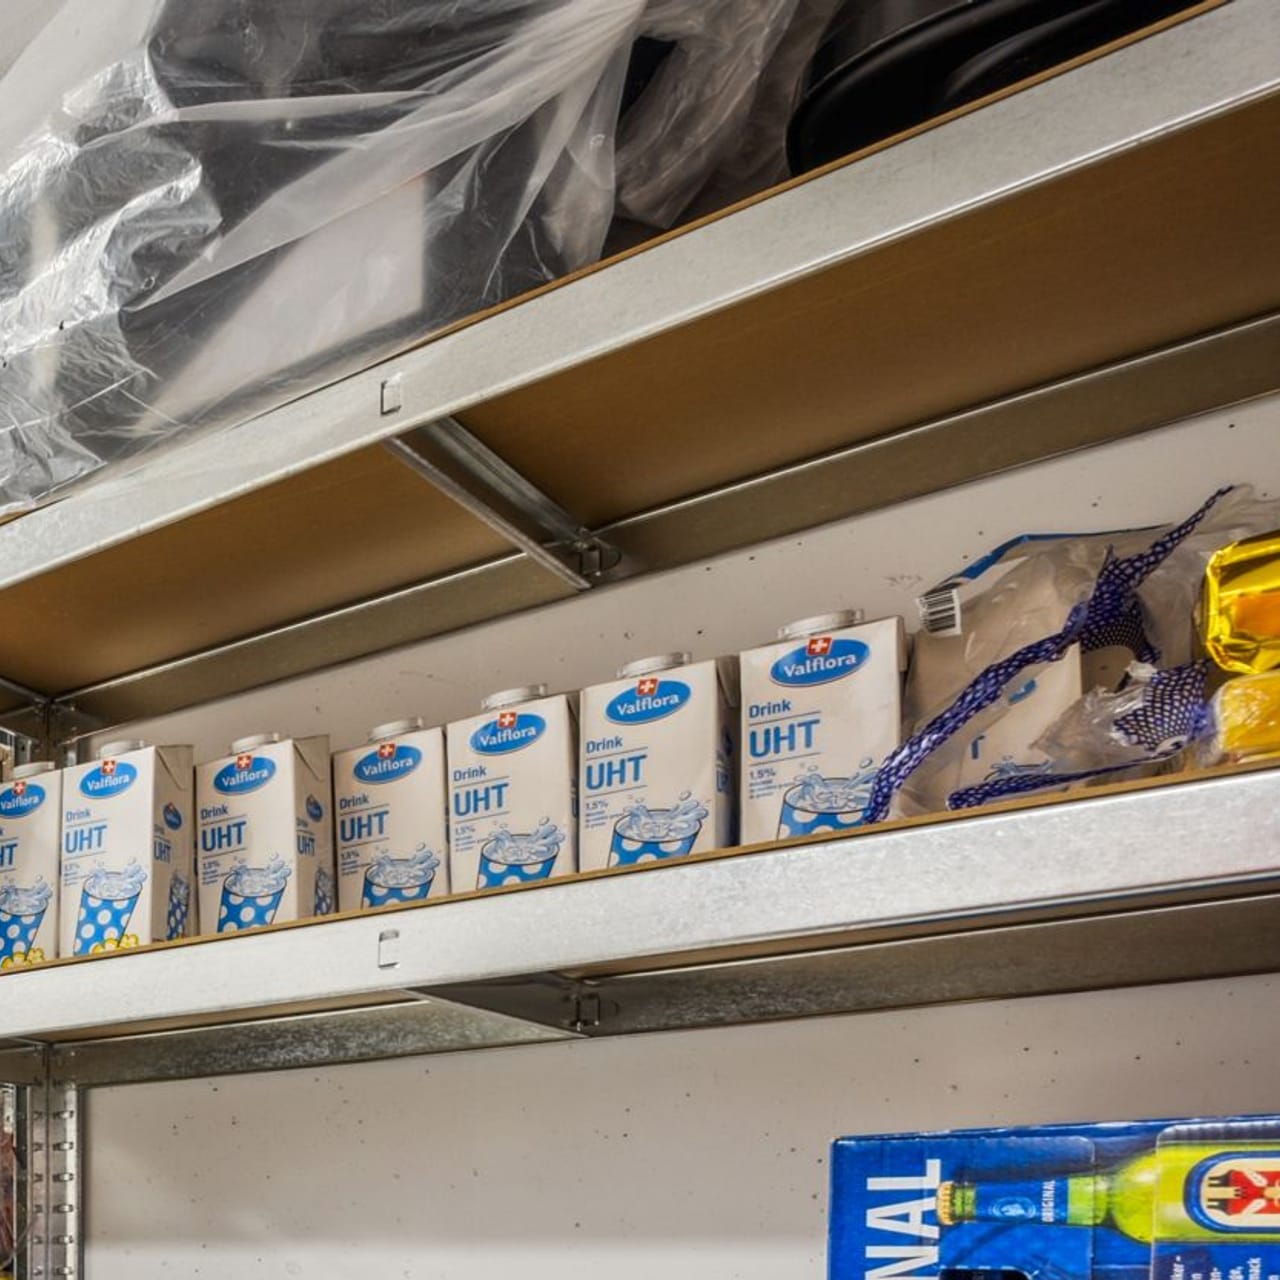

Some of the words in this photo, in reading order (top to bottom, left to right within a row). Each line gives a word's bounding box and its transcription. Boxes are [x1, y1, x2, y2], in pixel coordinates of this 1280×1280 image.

[784, 652, 856, 678] Valflora
[617, 692, 679, 716] Valflora
[749, 700, 790, 718] Drink
[480, 725, 536, 746] Valflora
[586, 736, 623, 754] Drink
[749, 719, 820, 757] UHT
[362, 756, 414, 776] Valflora
[453, 766, 486, 782] Drink
[586, 755, 646, 790] UHT
[87, 771, 129, 791] Valflora
[223, 768, 269, 788] Valflora
[0, 796, 39, 811] Valflora
[340, 794, 369, 810] Drink
[454, 783, 509, 816] UHT
[66, 808, 91, 821] Drink
[201, 804, 228, 819] Drink
[201, 821, 247, 852] UHT
[341, 810, 389, 842] UHT
[65, 825, 107, 853] UHT
[297, 834, 315, 857] UHT
[153, 841, 171, 863] UHT
[1041, 1180, 1055, 1223] ORIGINAL
